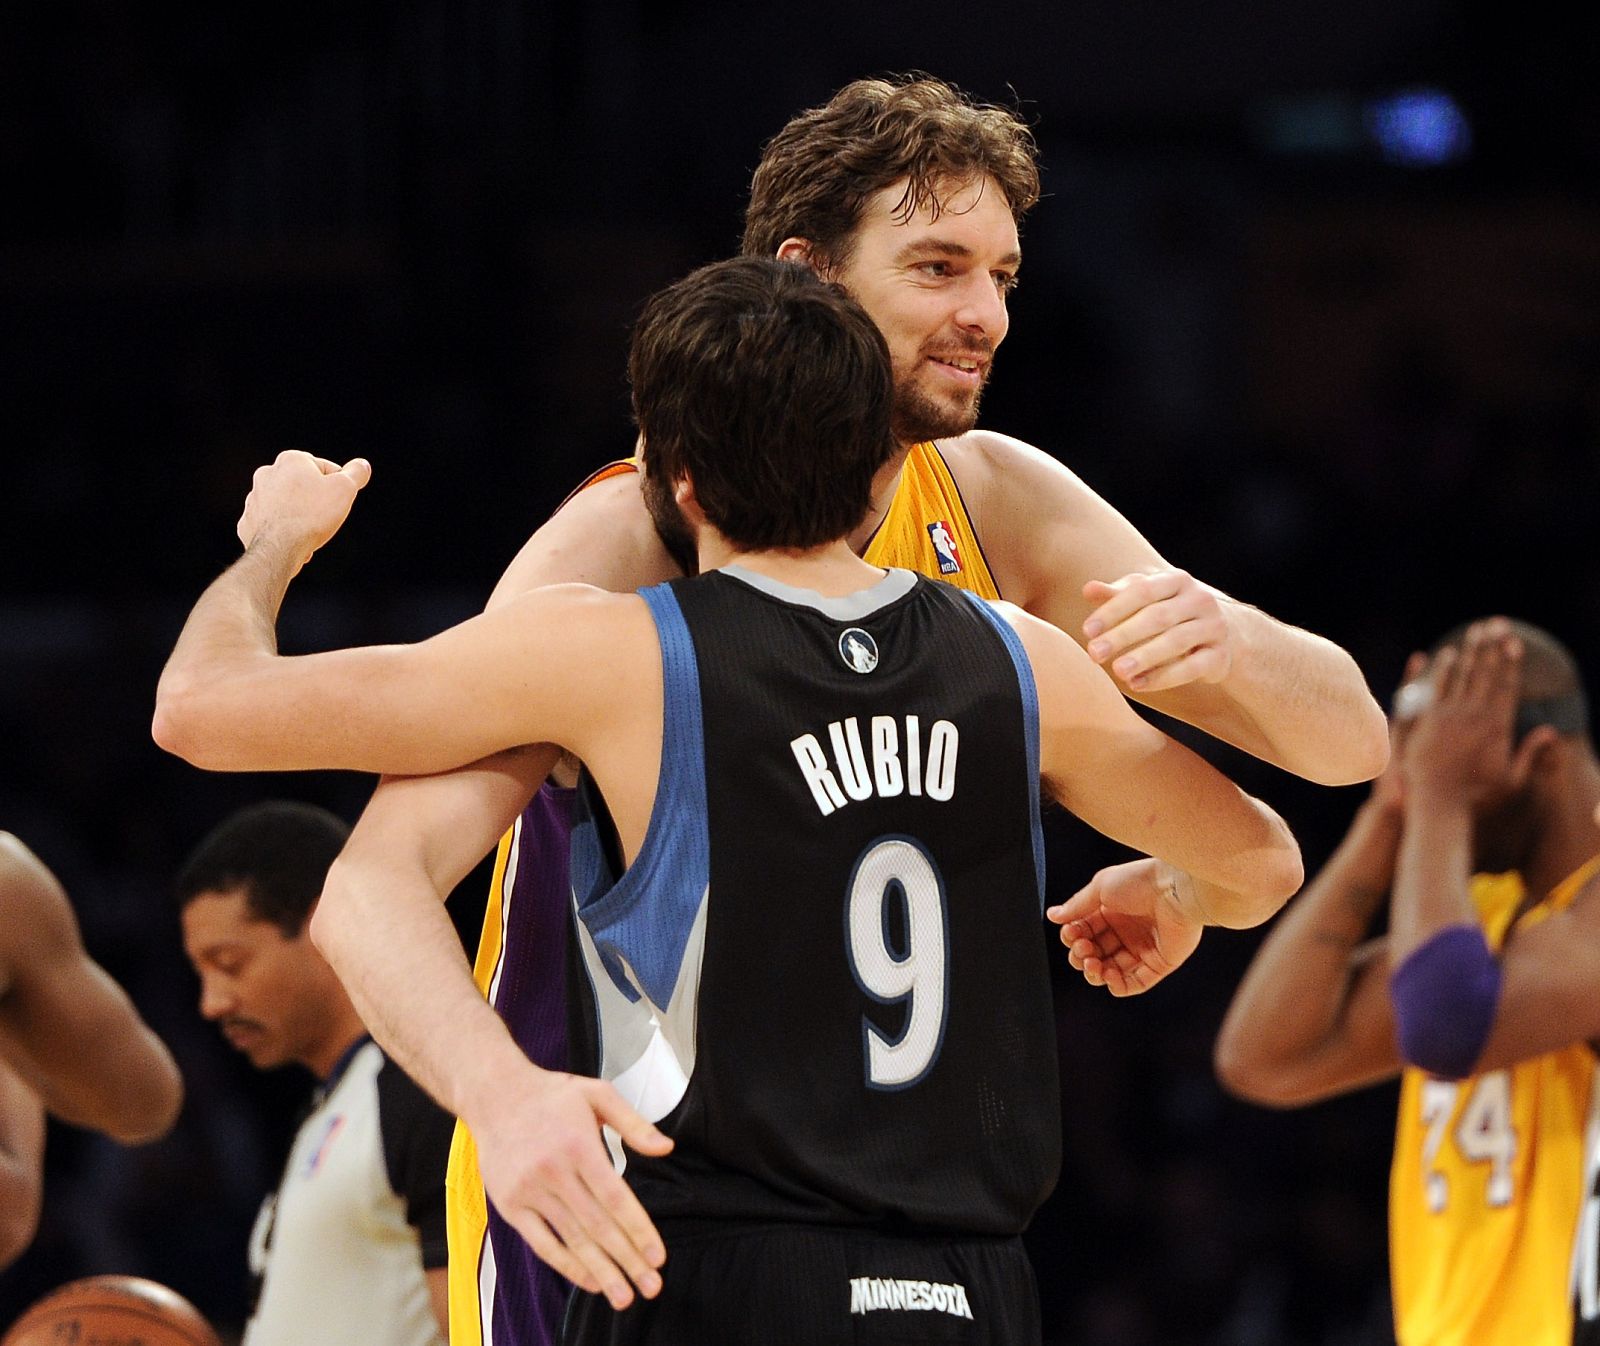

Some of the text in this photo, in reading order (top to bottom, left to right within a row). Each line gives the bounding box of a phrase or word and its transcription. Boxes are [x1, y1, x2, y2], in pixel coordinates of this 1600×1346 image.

[941, 561, 957, 573] NBA
[790, 714, 959, 816] RUBIO
[846, 836, 947, 1088] 9
[849, 1276, 974, 1320] MINNESOTA
